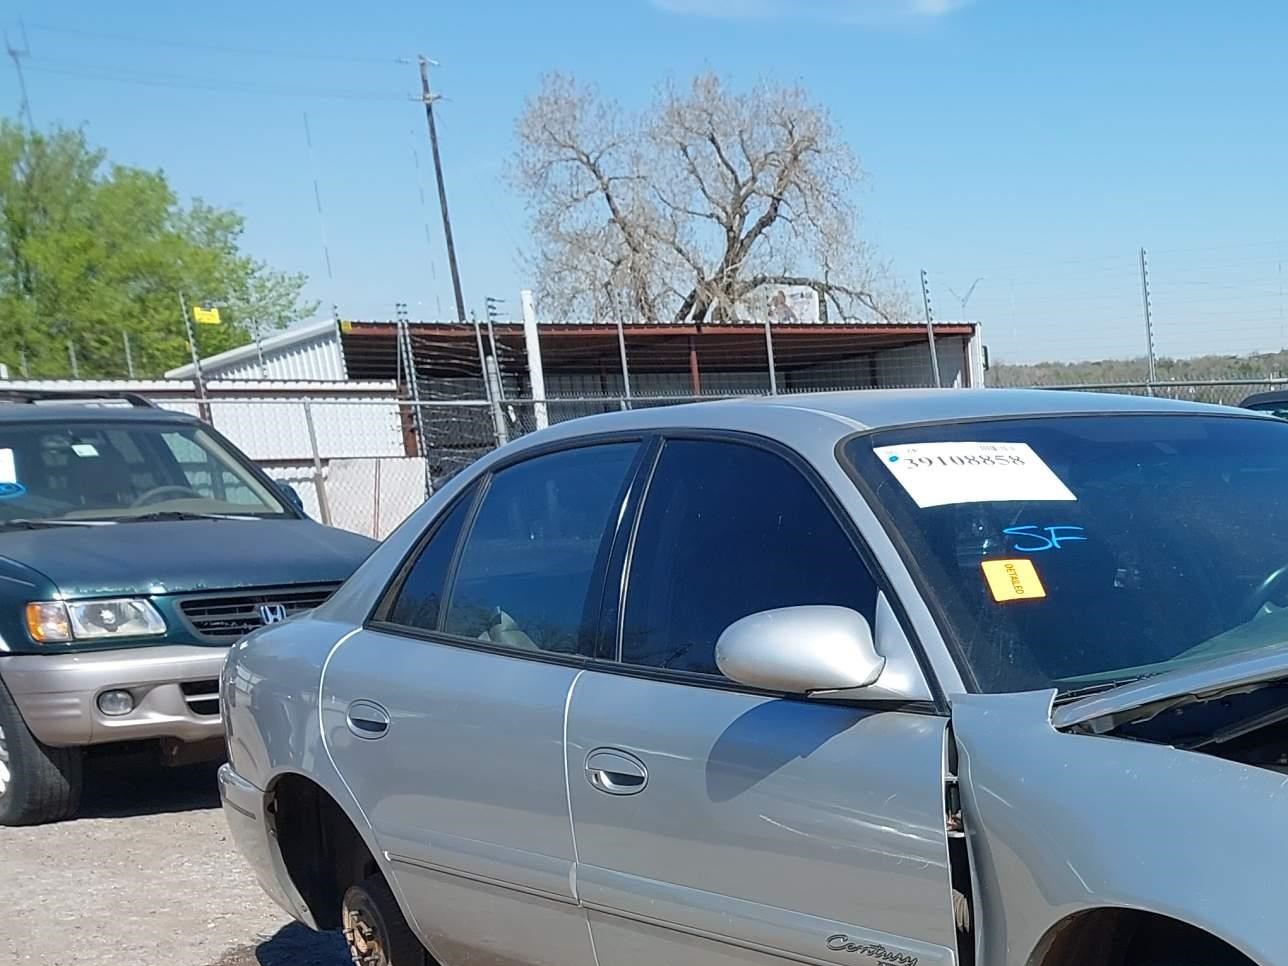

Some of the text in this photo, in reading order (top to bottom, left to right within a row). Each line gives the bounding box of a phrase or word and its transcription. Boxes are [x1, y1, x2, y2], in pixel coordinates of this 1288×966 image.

[903, 454, 1027, 470] 39108858
[1002, 525, 1088, 552] SF
[1004, 563, 1025, 595] DETAILED
